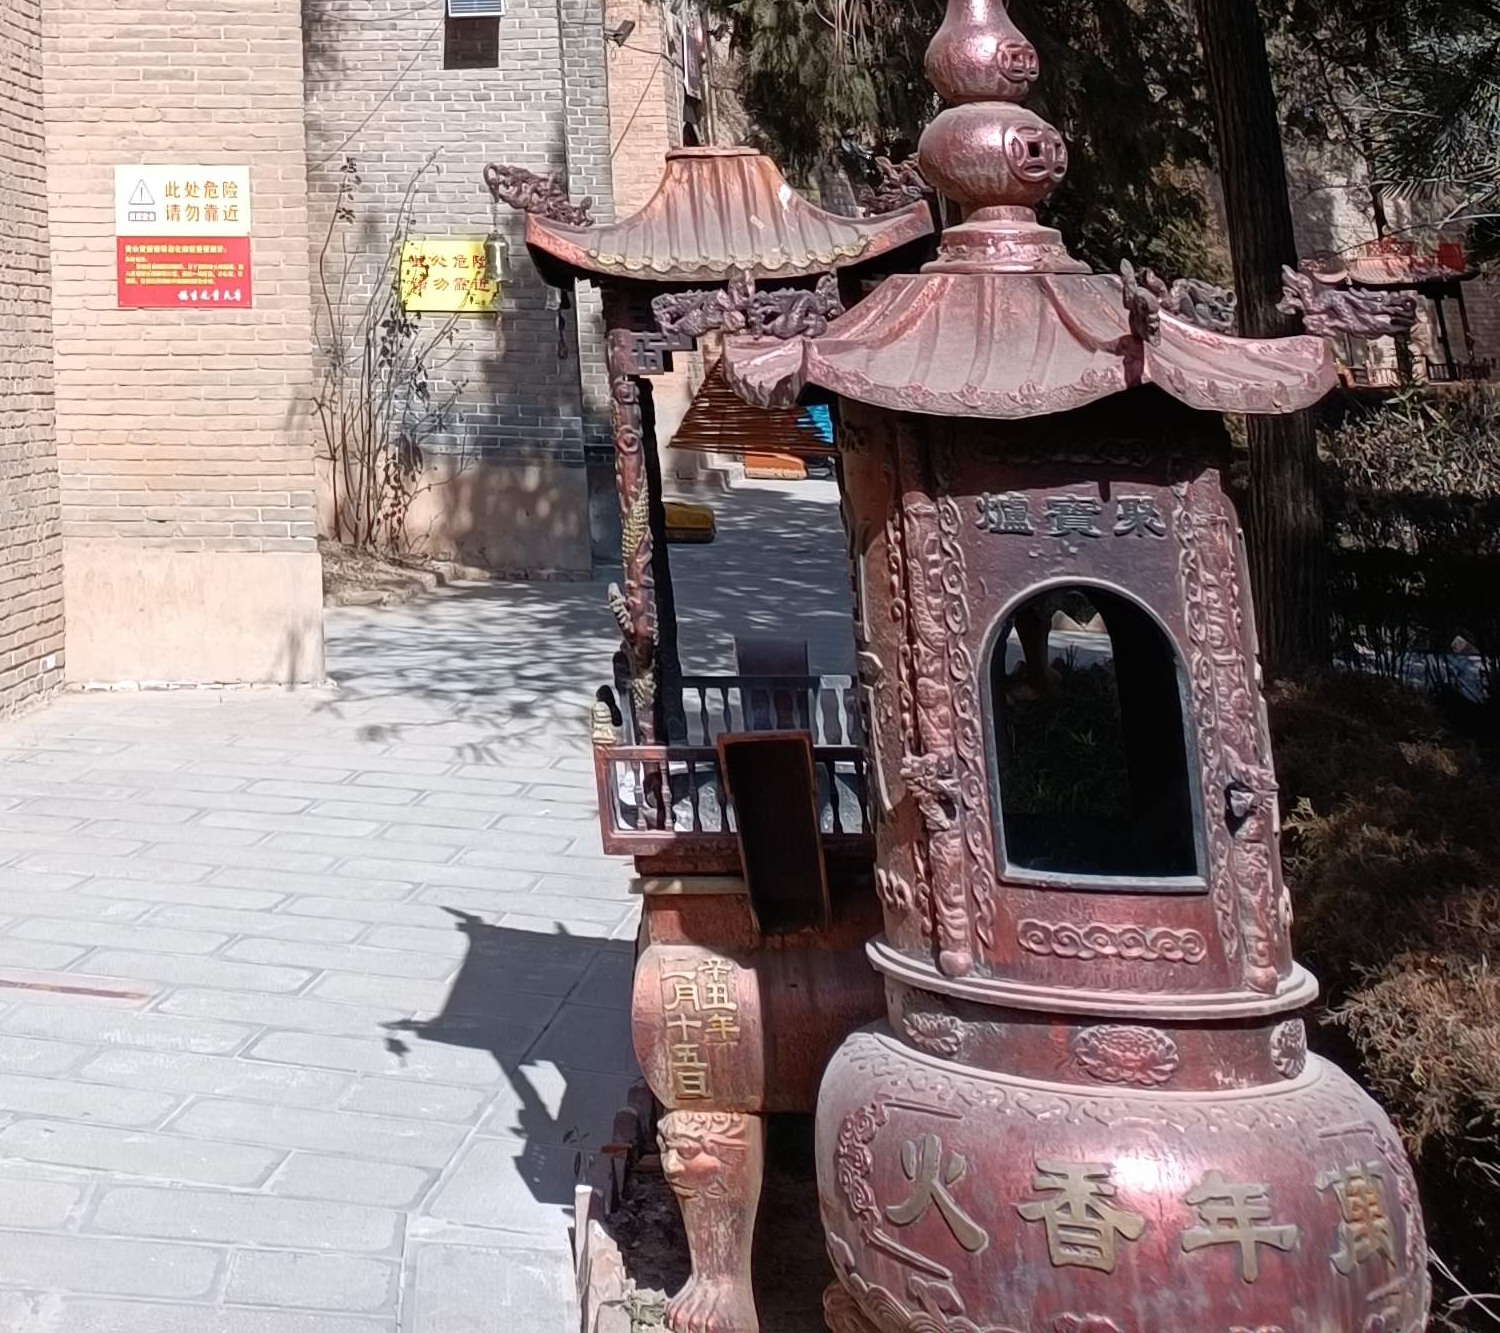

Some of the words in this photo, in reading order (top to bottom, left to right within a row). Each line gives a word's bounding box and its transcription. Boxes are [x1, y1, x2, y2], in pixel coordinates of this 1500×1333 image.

[165, 180, 239, 199] 此处危险
[166, 203, 240, 222] 请勿靠近
